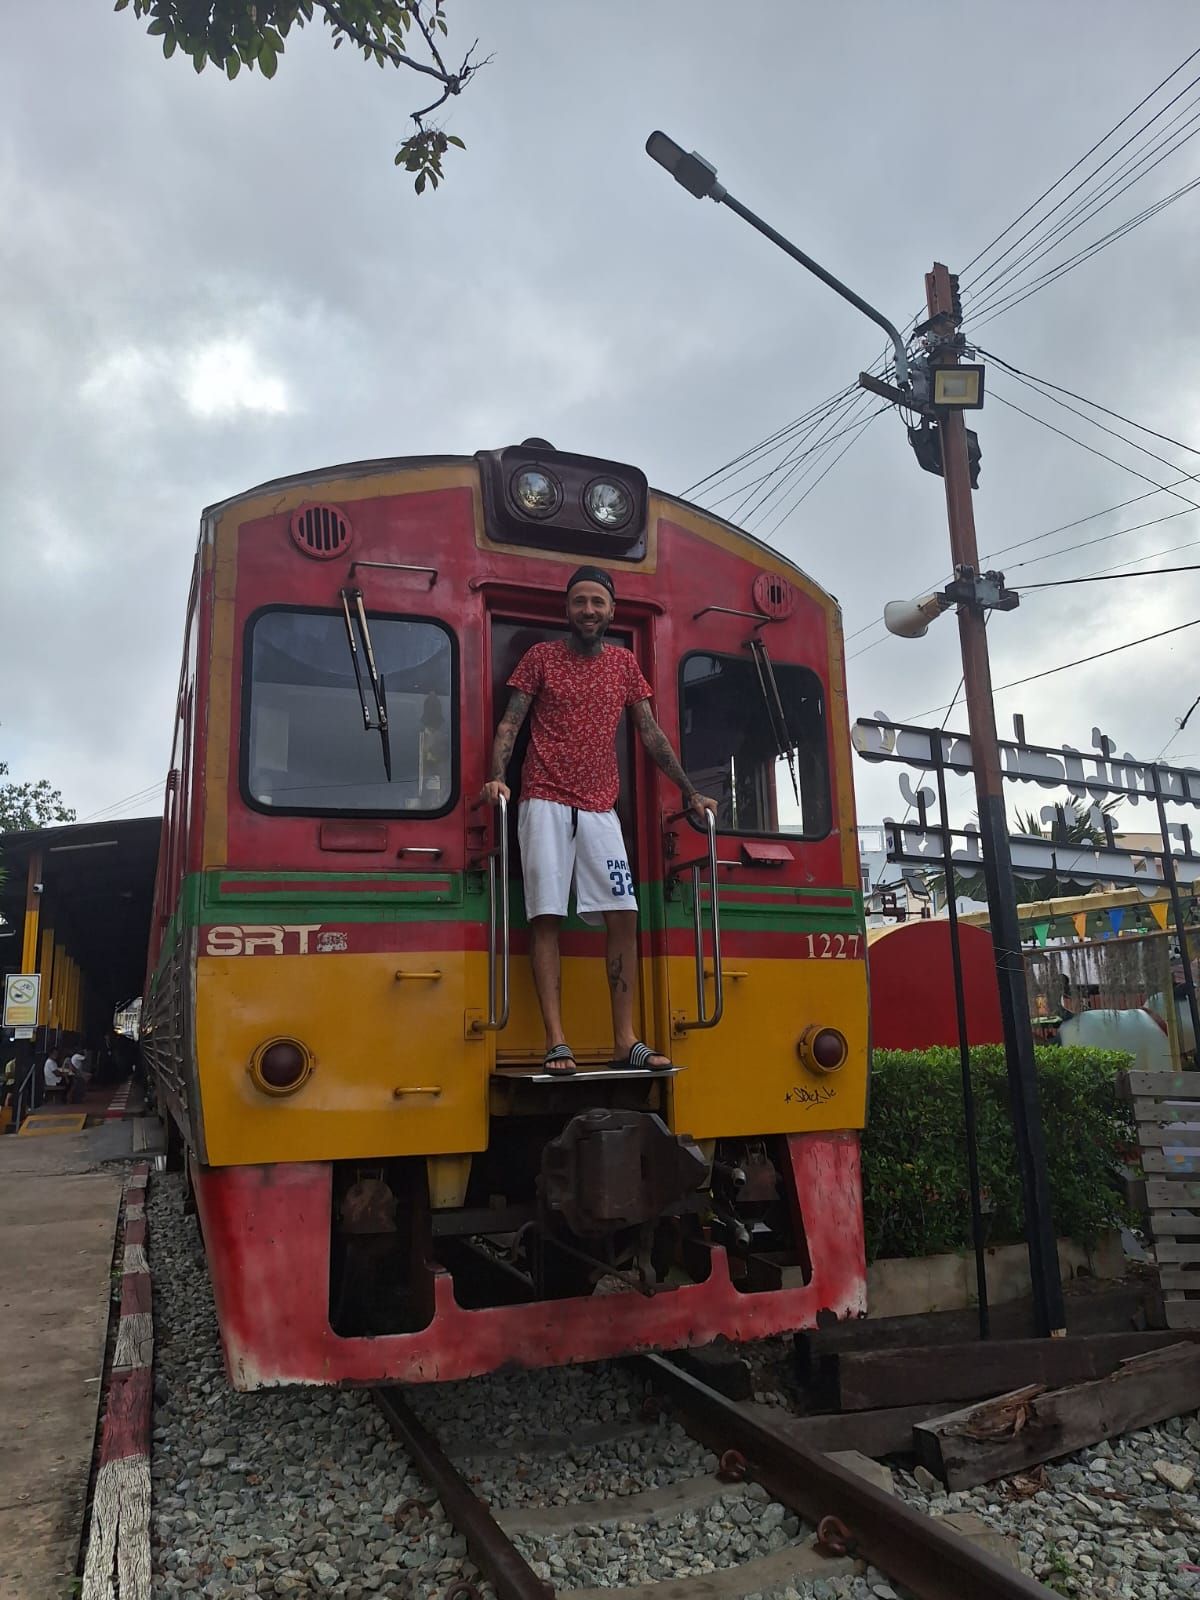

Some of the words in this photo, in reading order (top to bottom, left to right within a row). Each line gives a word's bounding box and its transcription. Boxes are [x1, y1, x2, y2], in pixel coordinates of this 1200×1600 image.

[607, 860, 629, 871] PAR
[206, 924, 322, 956] SRT
[805, 933, 859, 959] 1227
